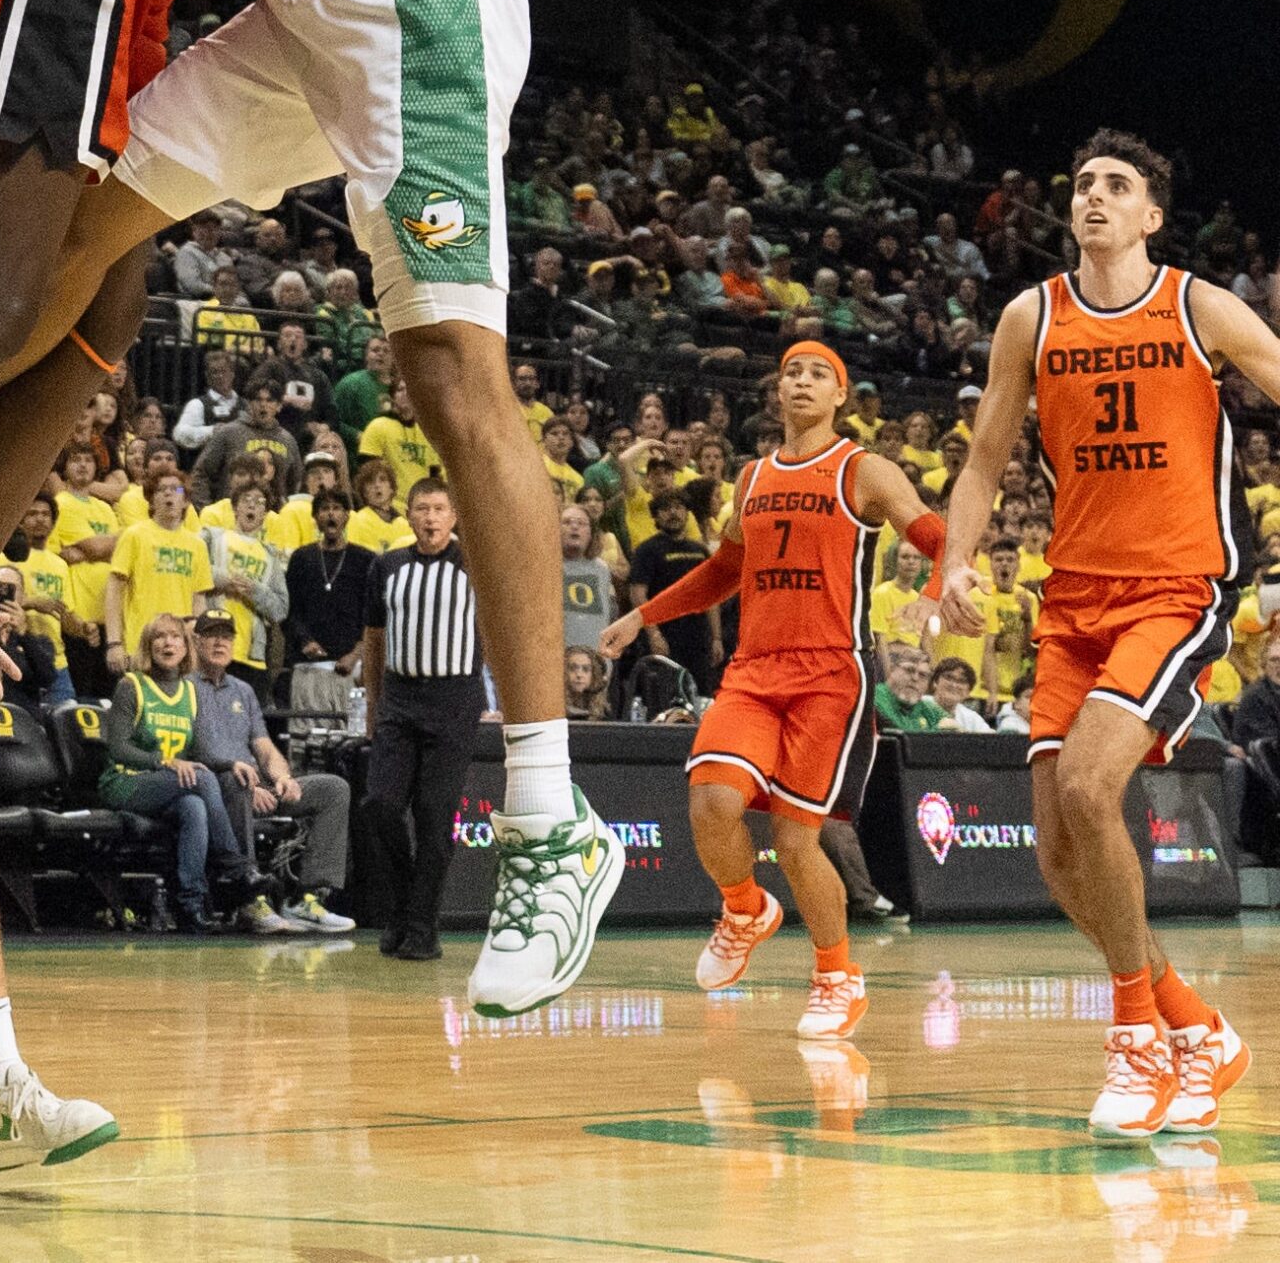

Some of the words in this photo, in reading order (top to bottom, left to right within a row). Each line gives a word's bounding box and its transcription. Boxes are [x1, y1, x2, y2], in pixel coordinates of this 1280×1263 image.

[1047, 342, 1185, 376] OREGON
[1095, 381, 1139, 434] 31
[1075, 442, 1168, 473] STATE
[745, 492, 838, 516] OREGON
[774, 520, 791, 559] 7
[755, 569, 822, 591] STATE
[954, 825, 1020, 848] COOLEY
